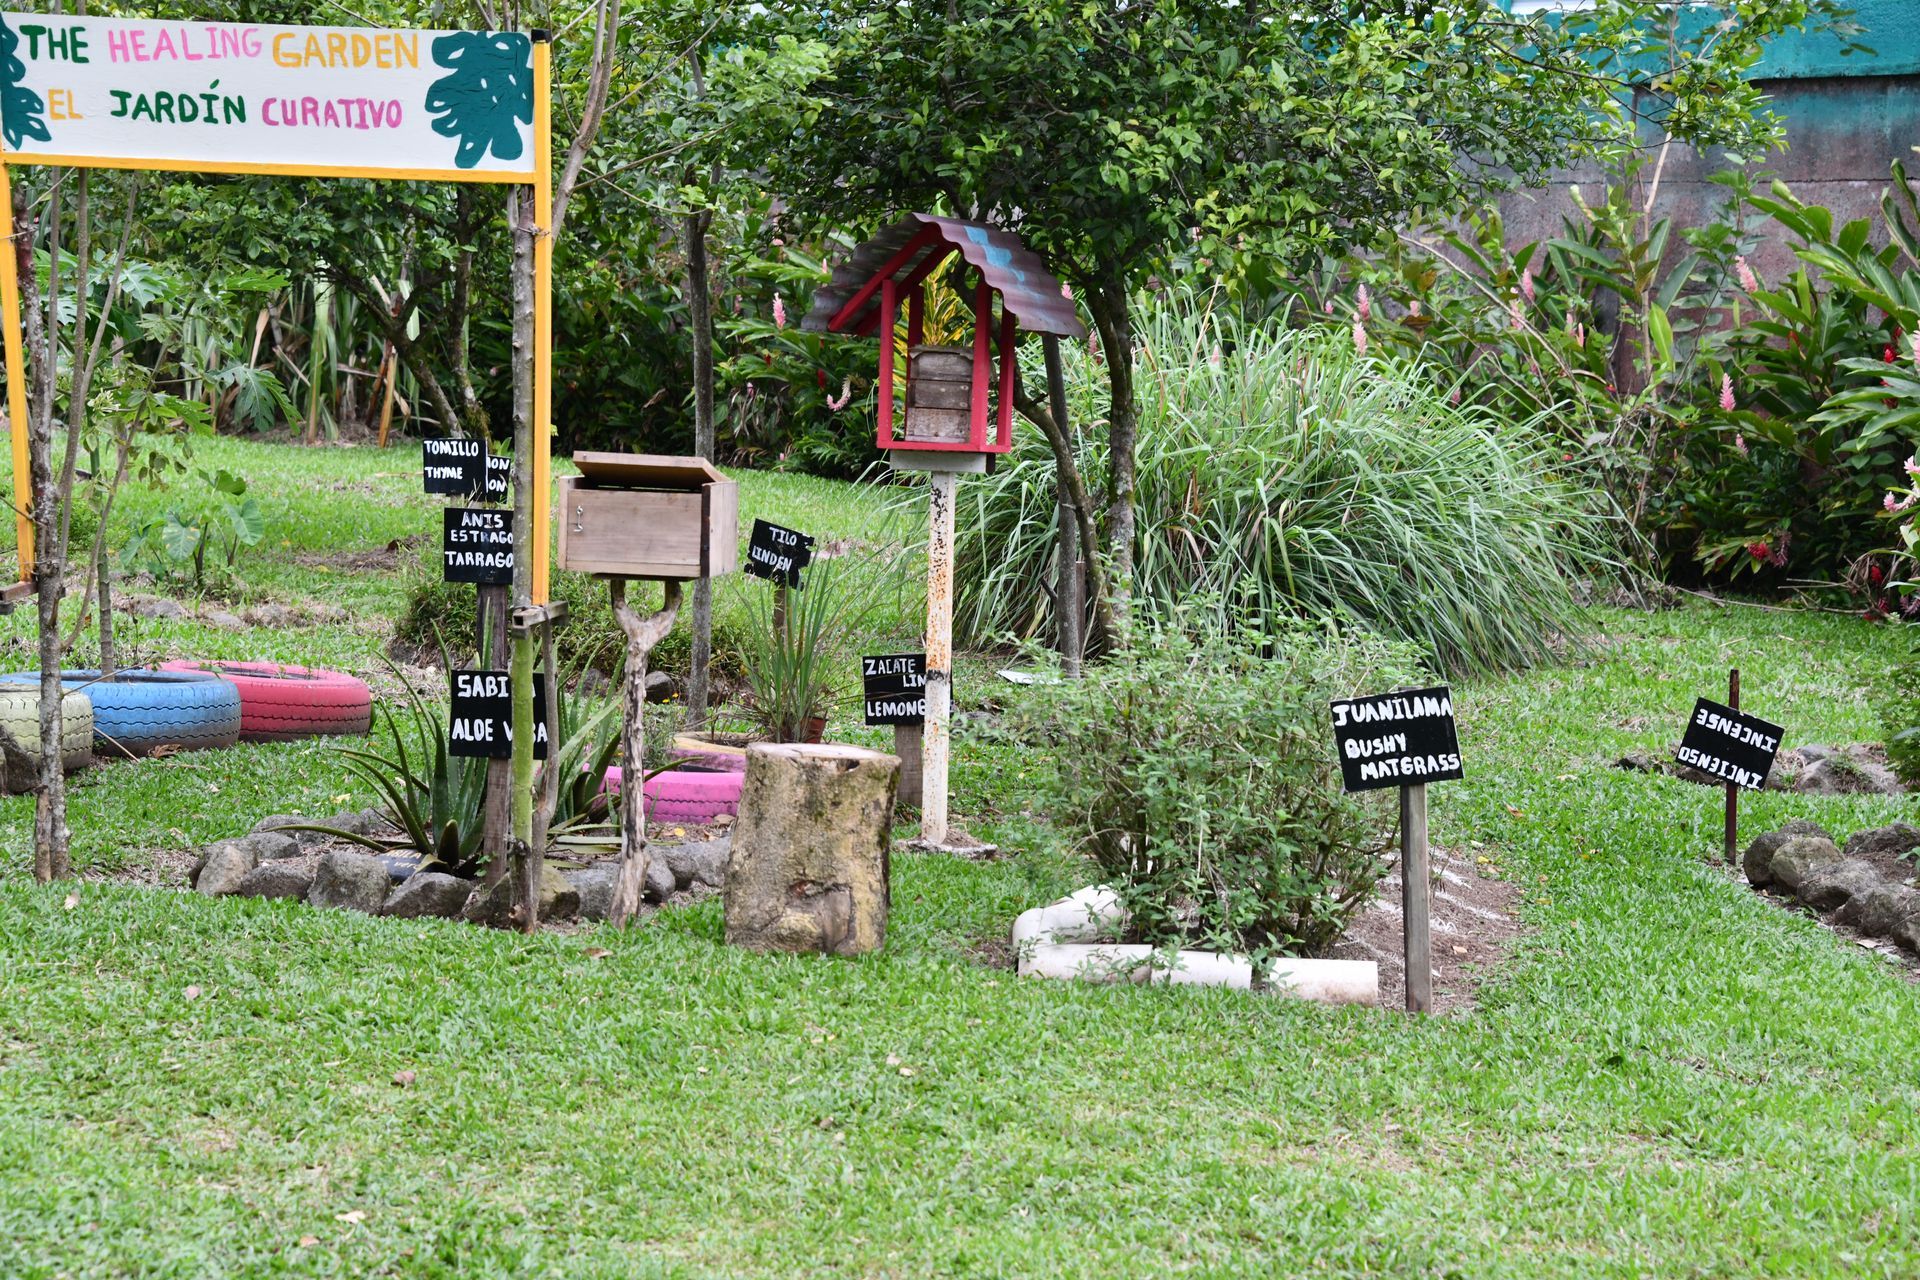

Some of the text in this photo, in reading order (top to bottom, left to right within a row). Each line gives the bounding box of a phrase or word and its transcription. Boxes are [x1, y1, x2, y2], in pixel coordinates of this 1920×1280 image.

[19, 24, 419, 69] THE HEALING GARDEN
[48, 78, 402, 130] EL JARDÍN CURATIVO
[424, 440, 479, 456] TOMILLO
[424, 466, 463, 480] THYME
[461, 511, 504, 529] ANIS
[450, 529, 514, 545] ESTRAGO
[768, 526, 798, 546] TILO
[444, 550, 514, 568] TARRAGO
[751, 545, 793, 572] LINDEN
[864, 658, 916, 676] ZACATE
[1332, 696, 1454, 727] JUANILAMA
[451, 718, 494, 742] ALOE
[1695, 708, 1778, 754] INCENSE
[1344, 732, 1407, 760] BUSHY
[1677, 746, 1764, 790] INCIENSO
